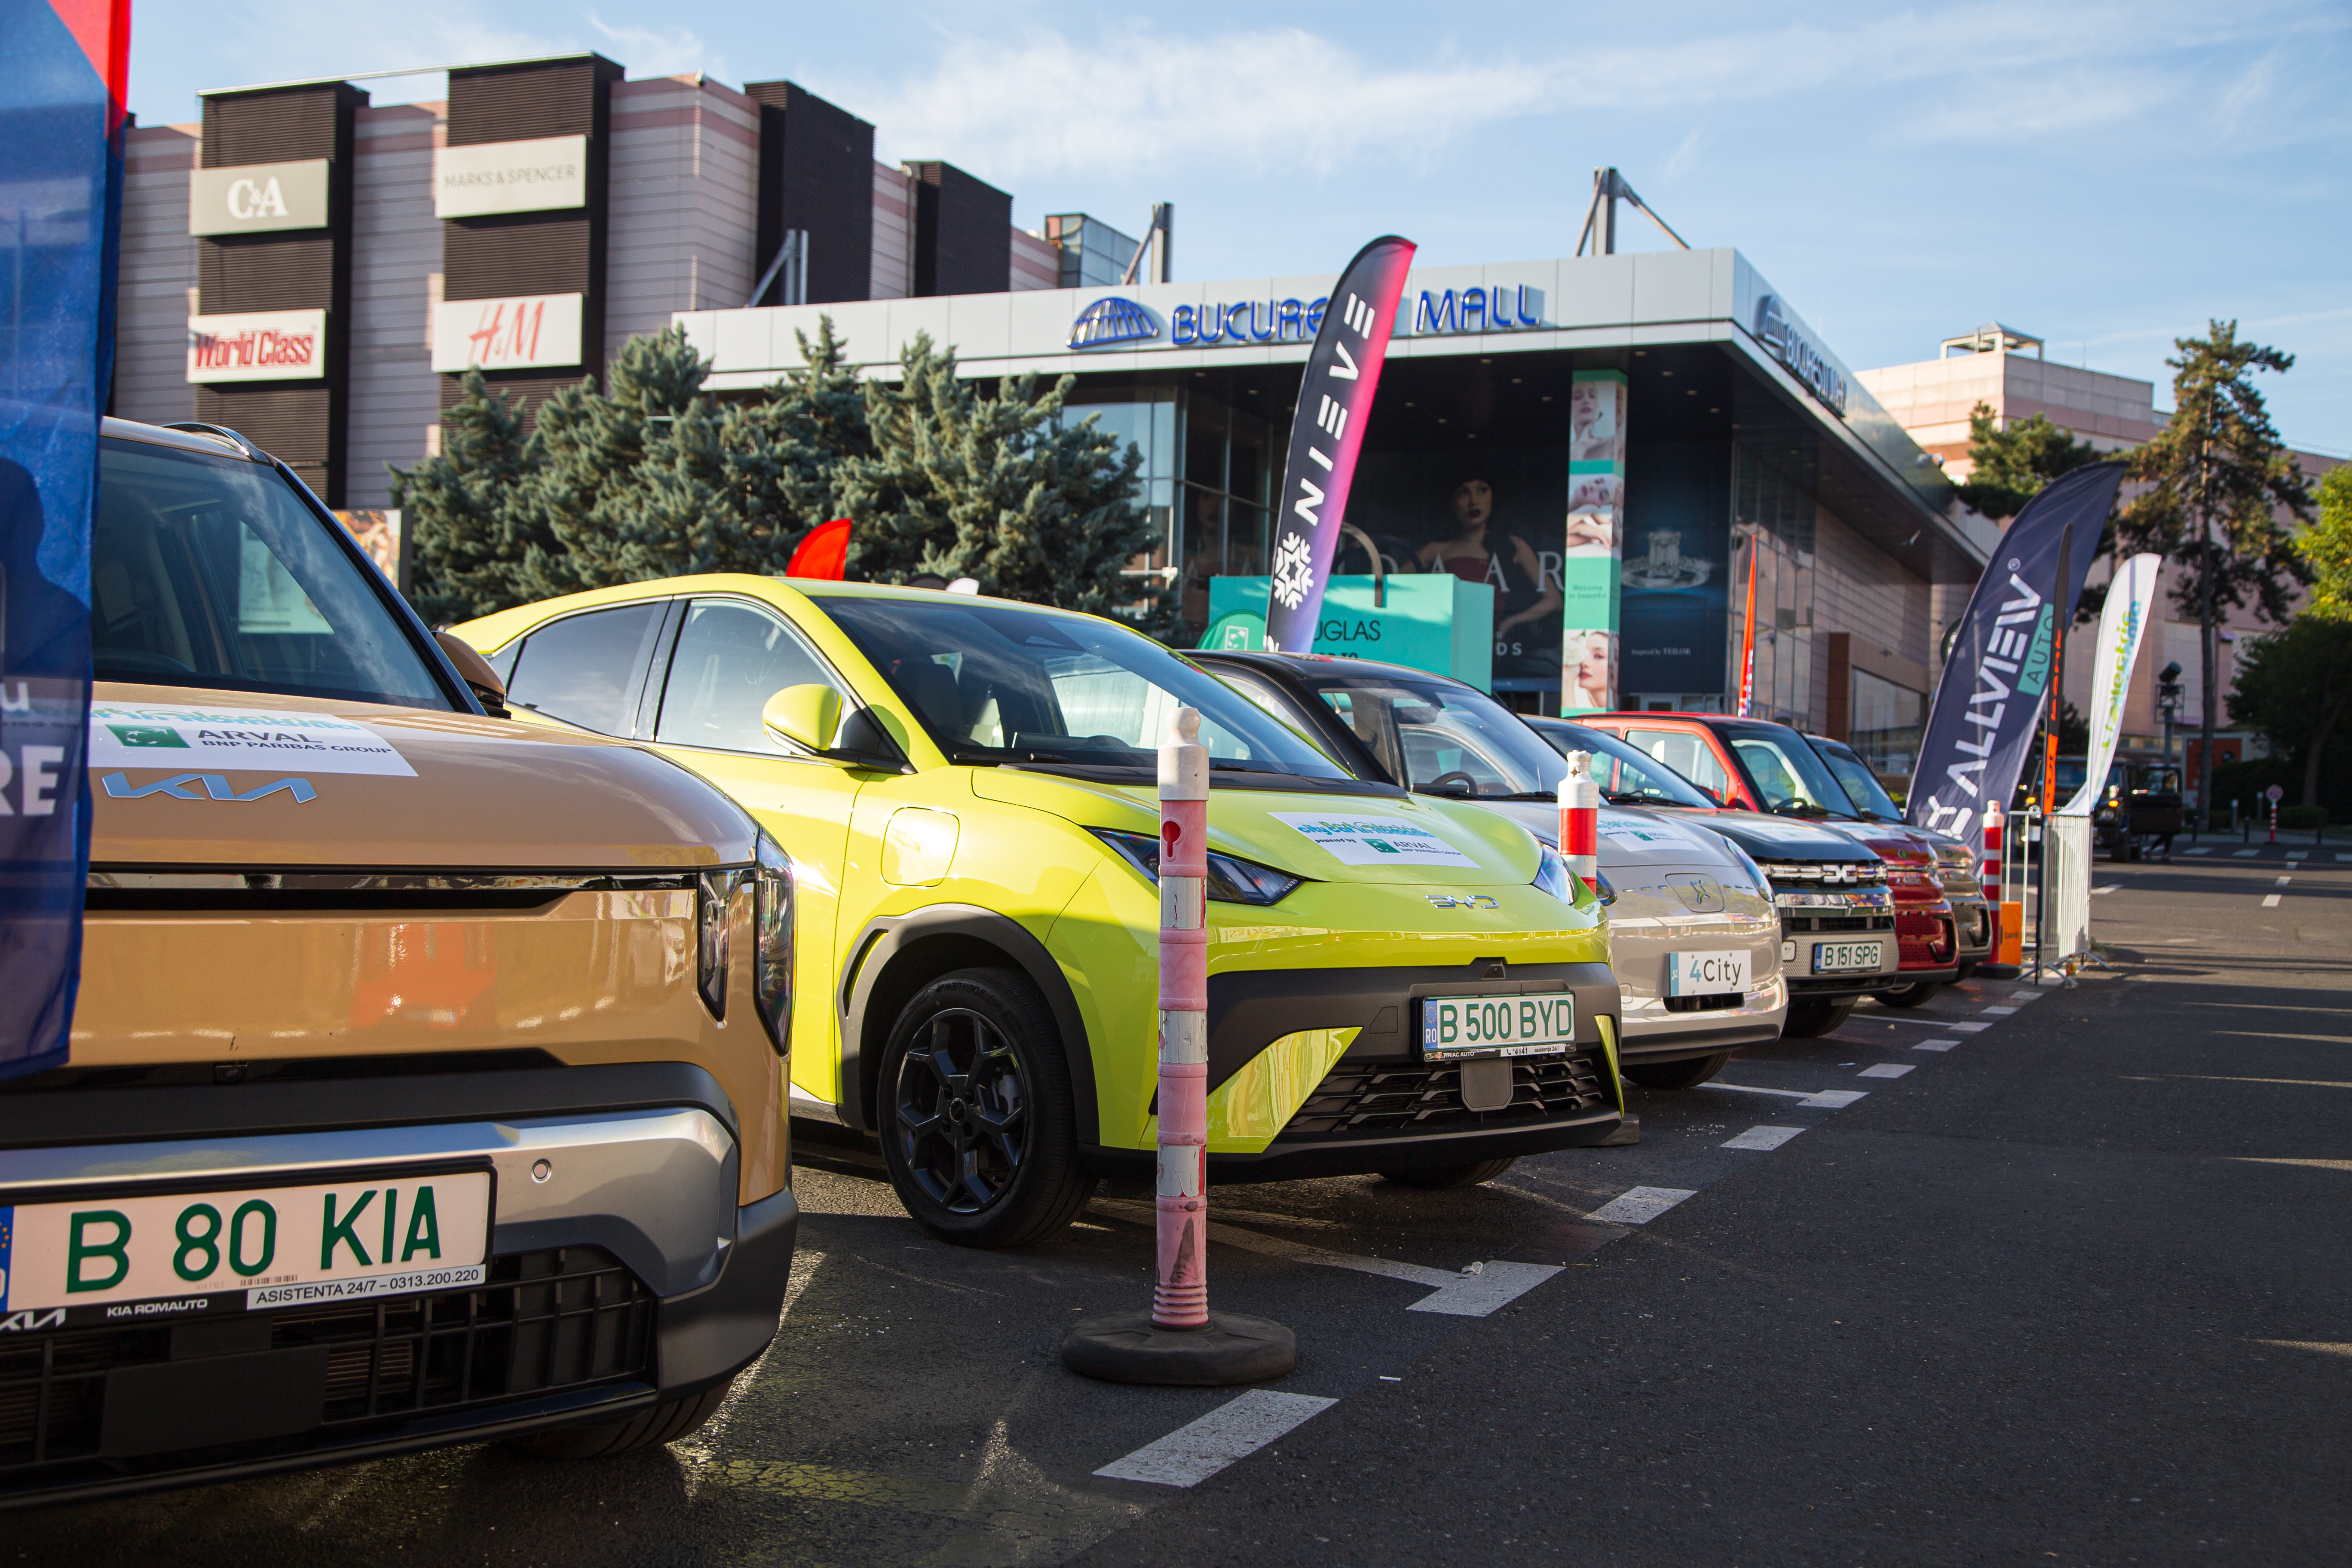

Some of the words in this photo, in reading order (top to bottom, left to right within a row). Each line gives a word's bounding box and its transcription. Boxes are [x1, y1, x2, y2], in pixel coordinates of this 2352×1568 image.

[227, 177, 289, 220] C&A
[1172, 297, 1330, 344] BUCURE
[1415, 284, 1540, 333] MALL
[196, 332, 257, 369] World
[257, 328, 313, 364] Class
[467, 301, 545, 363] H&M
[2027, 615, 2053, 685] AUTO
[198, 729, 322, 743] ARVAL
[248, 742, 326, 750] PARIBAS
[102, 771, 317, 804] KIA
[1393, 841, 1436, 849] ARVAL
[2005, 930, 2019, 939] bank
[1690, 958, 1742, 986] 4City
[1825, 947, 1834, 966] B
[1838, 946, 1852, 966] 151
[1855, 946, 1878, 965] SPG
[1426, 1028, 1436, 1043] RO
[1440, 1004, 1458, 1043] B
[1466, 1001, 1512, 1041] 500
[1520, 999, 1572, 1038] BYD
[67, 1210, 132, 1293] B
[173, 1199, 277, 1281] 80
[320, 1185, 441, 1270] KIA
[257, 1283, 343, 1304] ASISTENTA
[347, 1280, 377, 1295] 24/7
[390, 1269, 479, 1290] 0313.200.220
[107, 1305, 132, 1317] KIA
[135, 1298, 208, 1315] ROMAUTO
